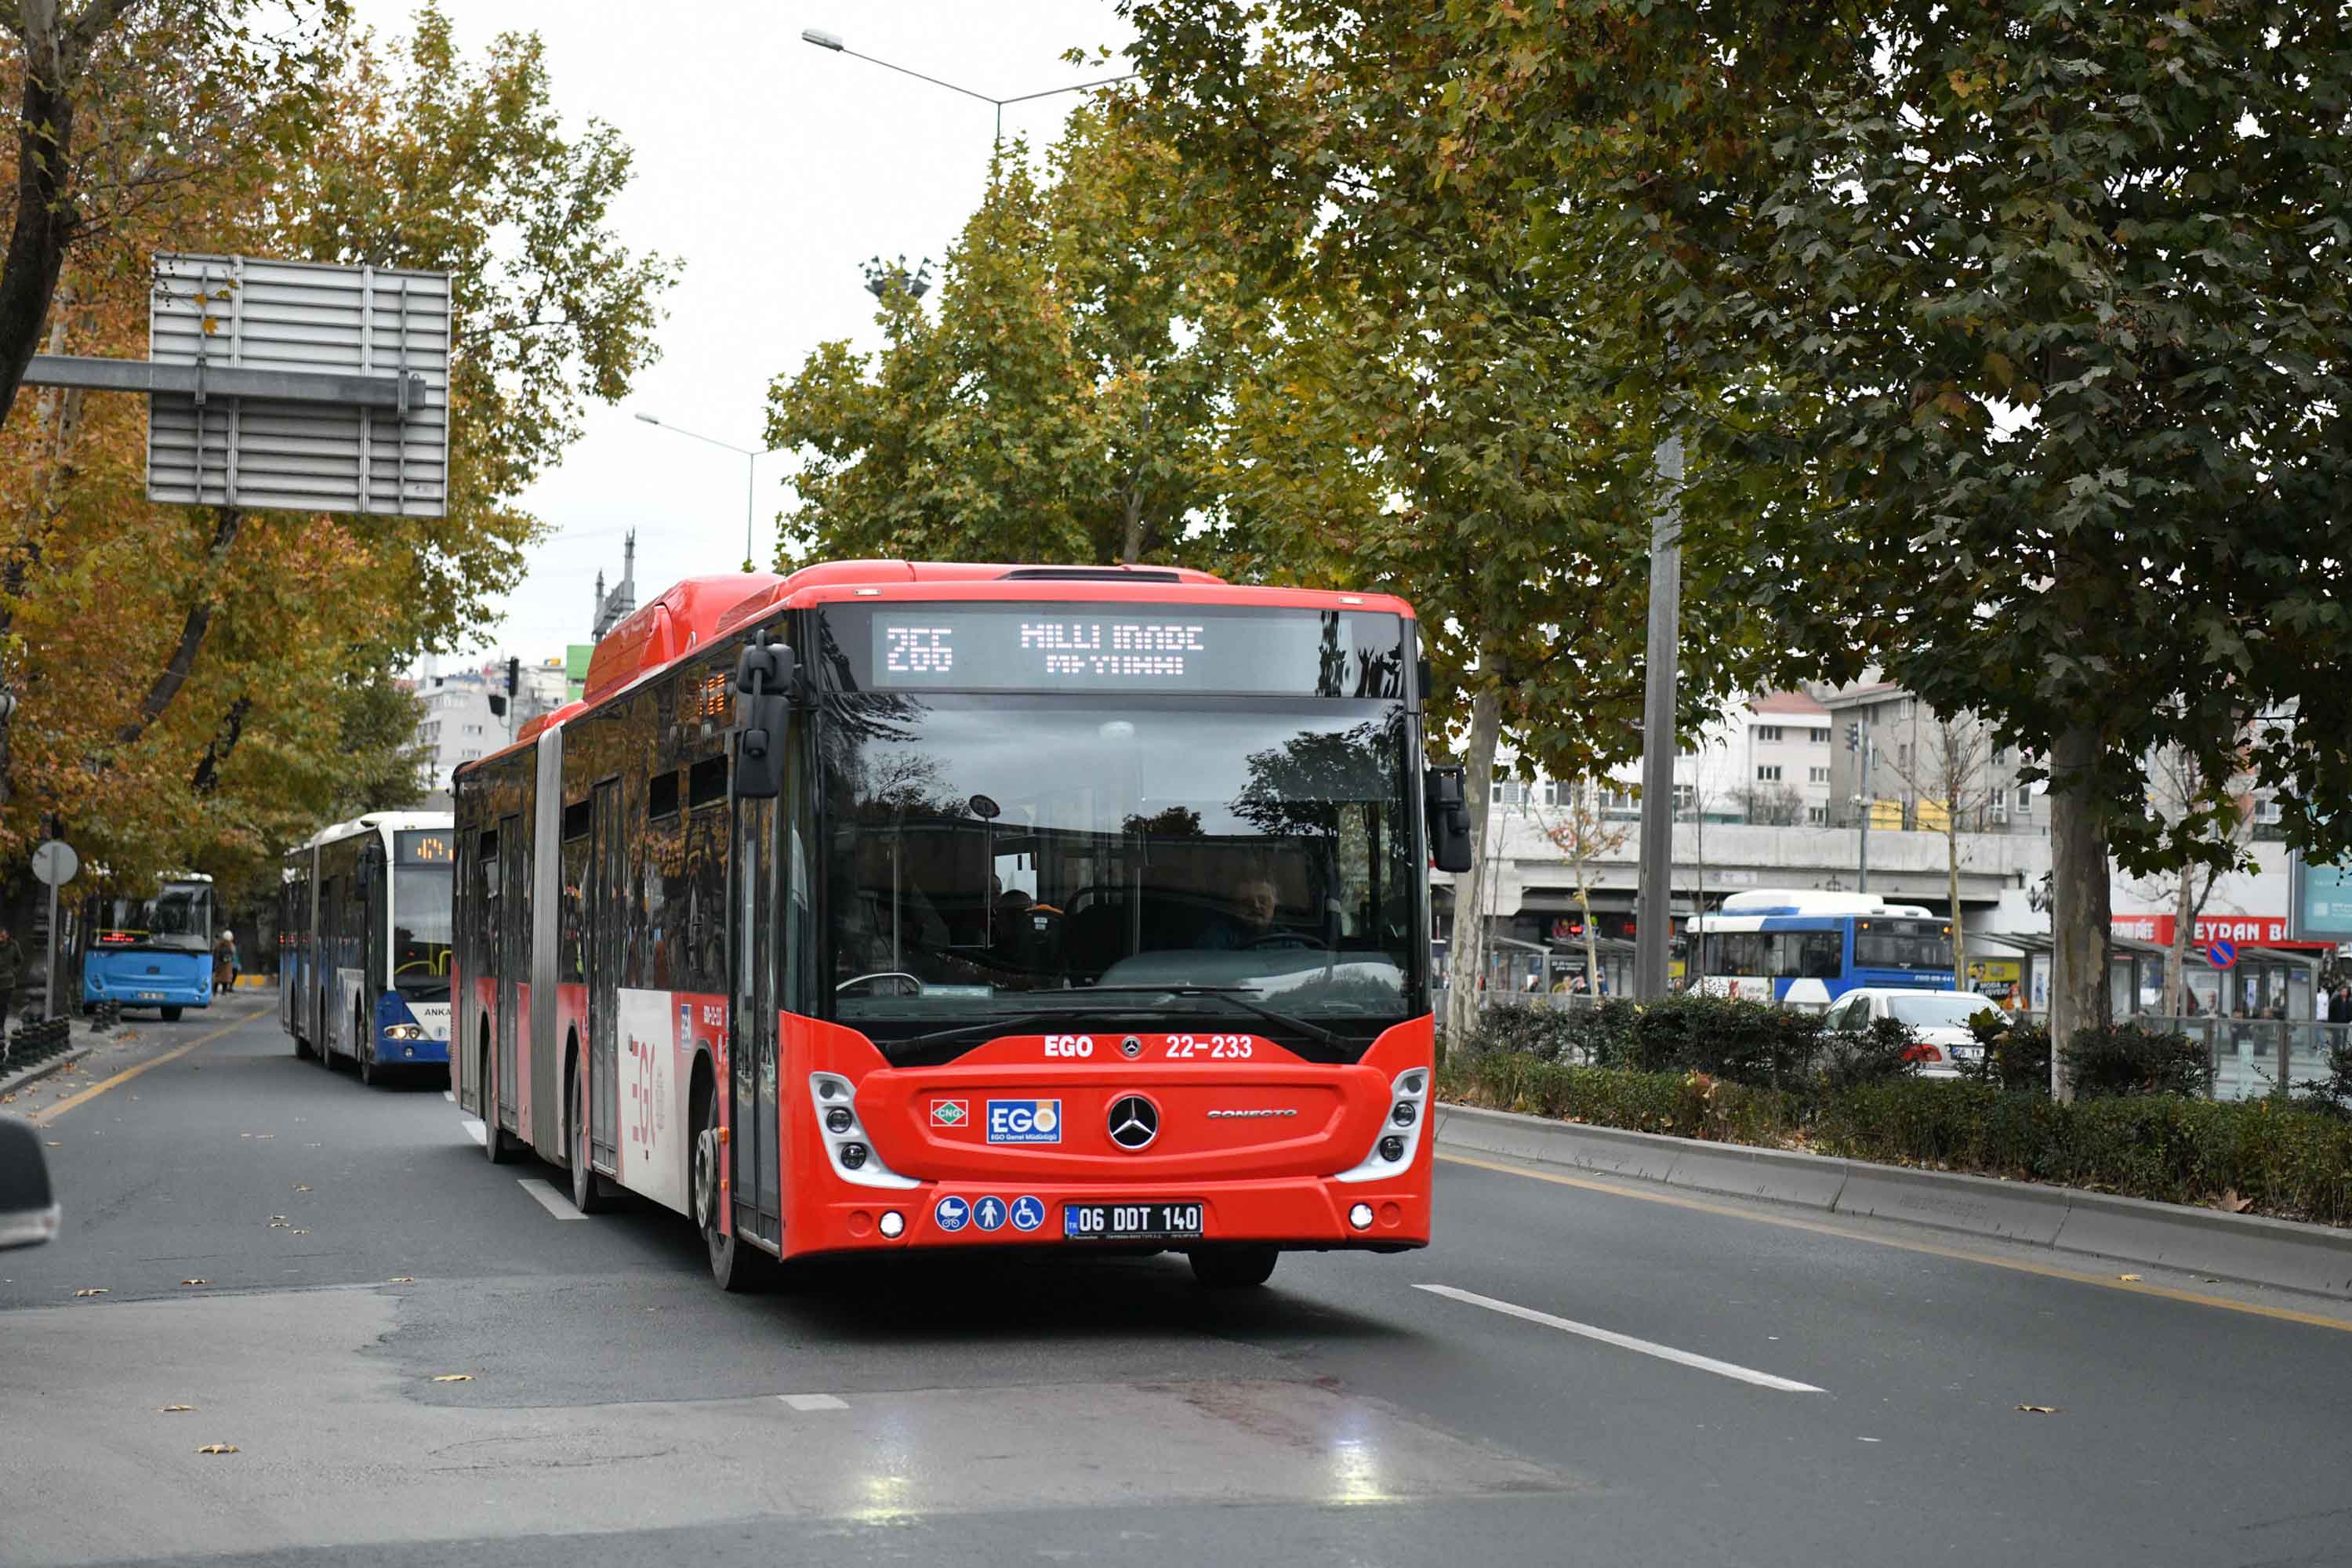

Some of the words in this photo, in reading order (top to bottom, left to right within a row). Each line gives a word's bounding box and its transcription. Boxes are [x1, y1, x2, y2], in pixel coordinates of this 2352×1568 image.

[887, 627, 953, 672] 266
[1044, 1034, 1094, 1058] EGO
[1166, 1035, 1253, 1058] 22-233
[938, 1109, 960, 1117] CNG
[991, 1108, 1058, 1133] EGO
[1207, 1109, 1298, 1118] CONECTO
[1079, 1207, 1104, 1232] 06
[1113, 1207, 1151, 1231] DDT
[1163, 1207, 1198, 1231] 140
